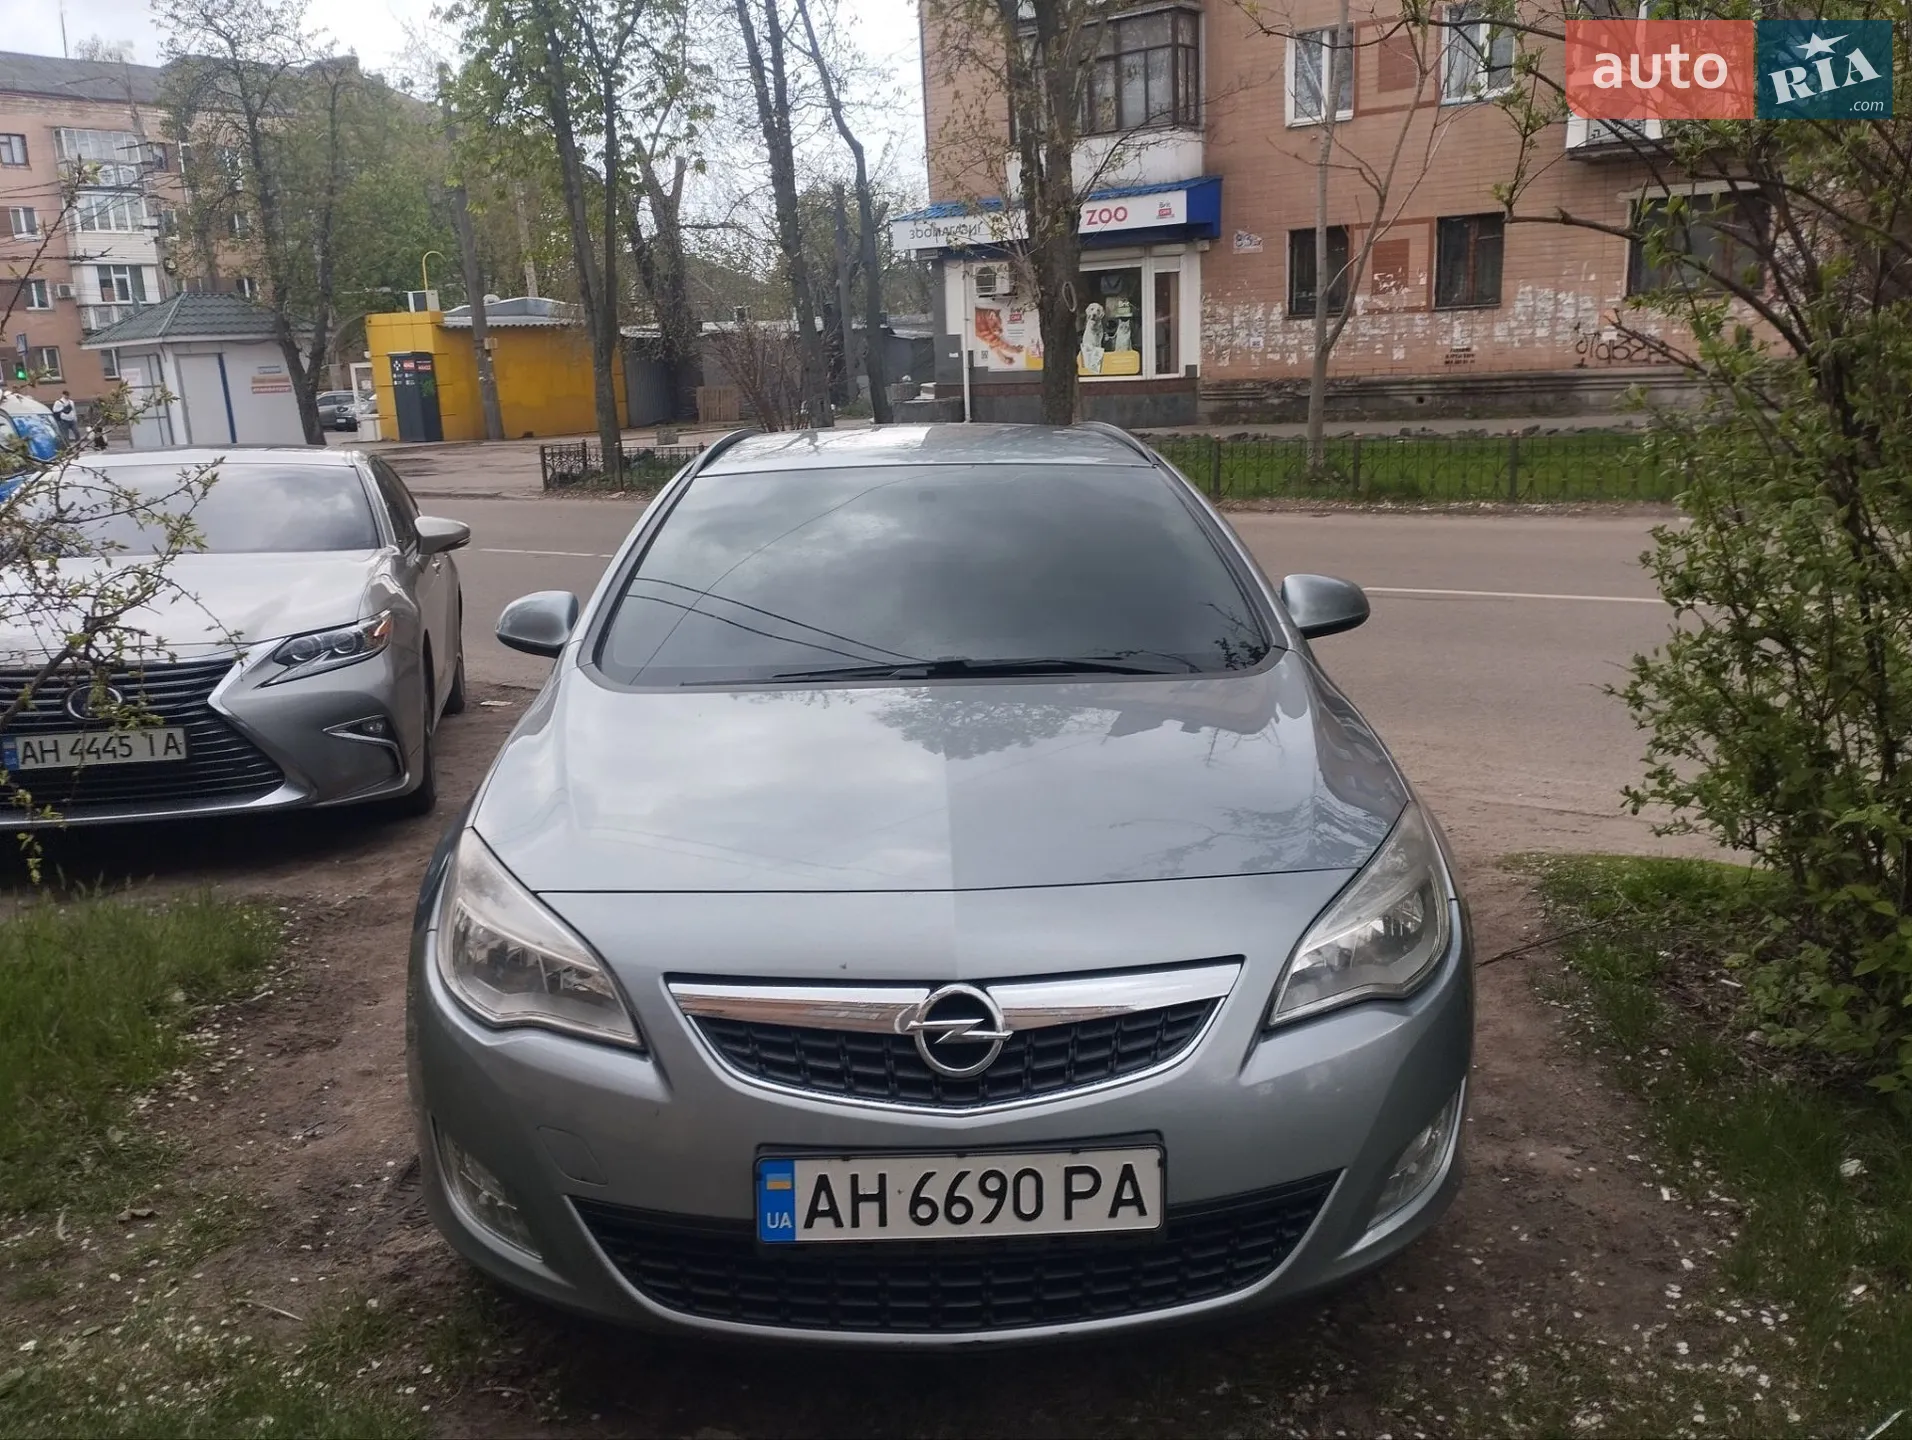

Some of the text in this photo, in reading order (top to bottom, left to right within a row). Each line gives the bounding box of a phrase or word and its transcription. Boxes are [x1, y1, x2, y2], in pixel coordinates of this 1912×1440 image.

[1086, 206, 1128, 226] ZOO
[20, 739, 61, 765] AH
[69, 735, 132, 761] 4445
[803, 1163, 1148, 1229] AH 6690 PA
[766, 1211, 793, 1229] UA
